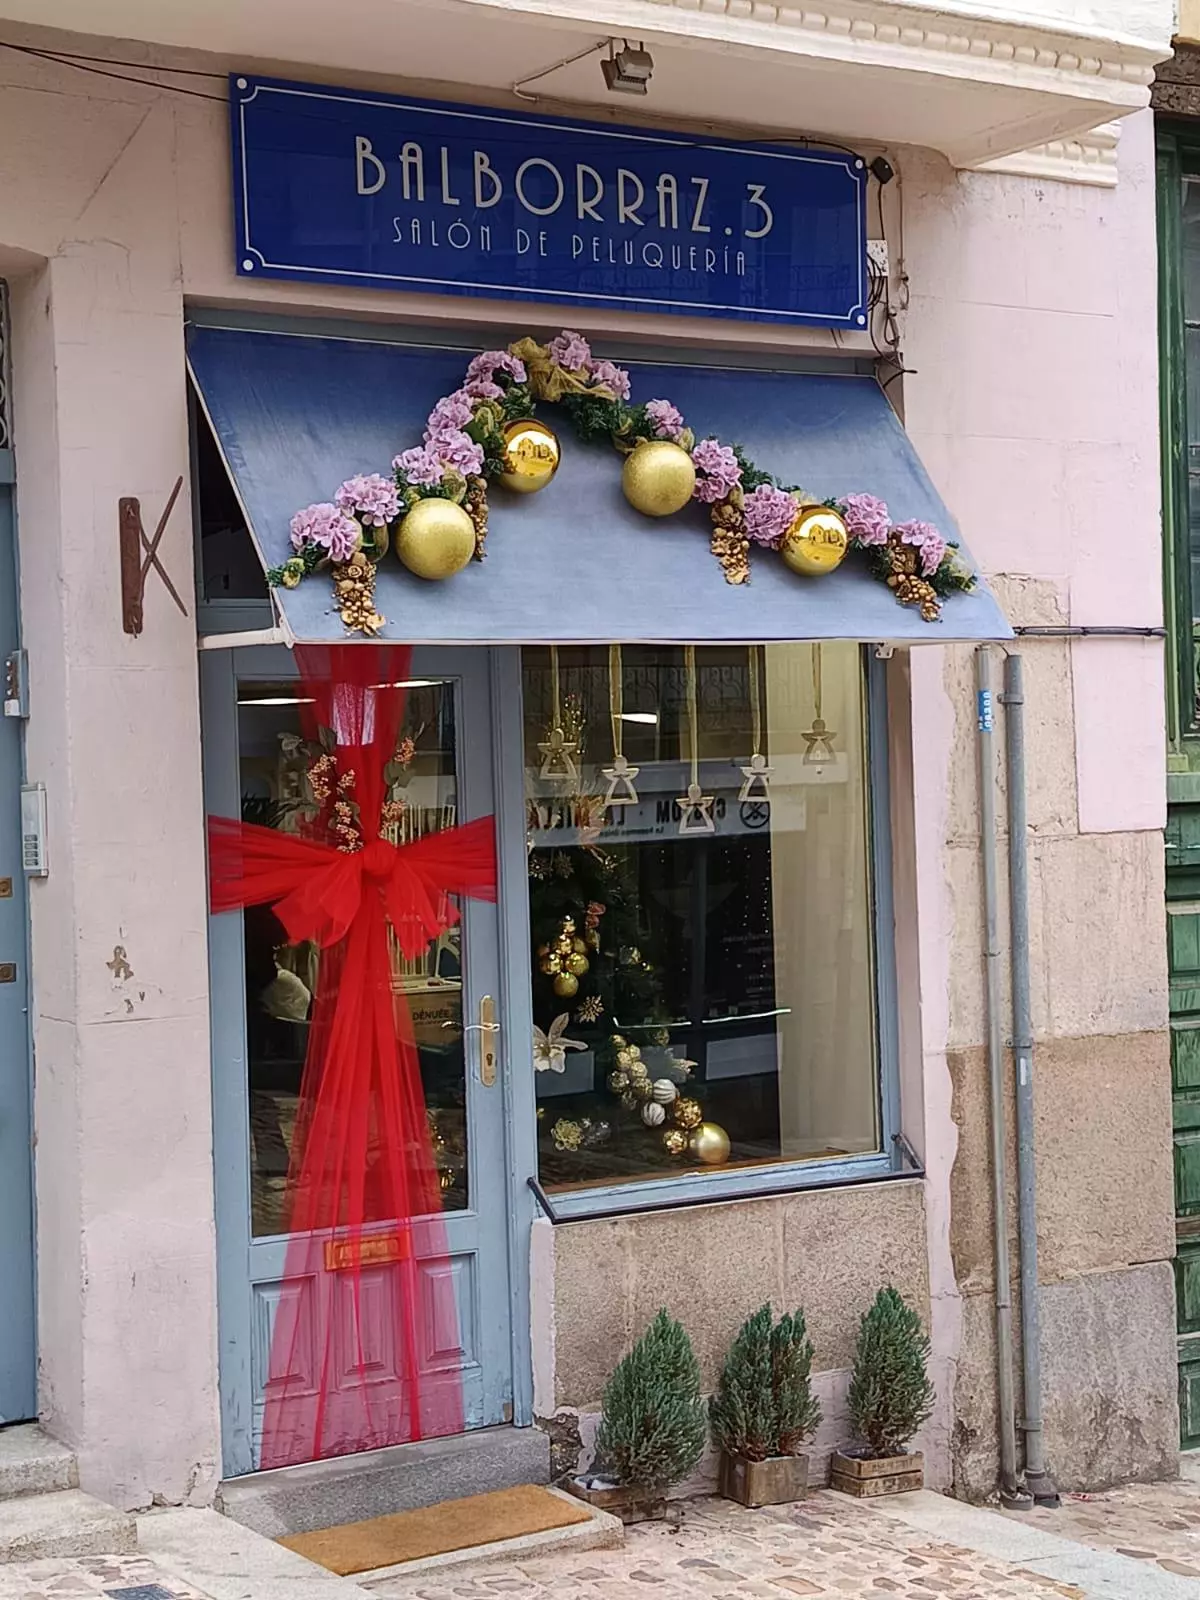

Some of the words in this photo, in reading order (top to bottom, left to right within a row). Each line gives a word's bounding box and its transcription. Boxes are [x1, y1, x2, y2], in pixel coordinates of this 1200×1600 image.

[393, 215, 491, 251] SALÓN
[516, 228, 548, 257] DE
[572, 234, 745, 276] PELUQUERÍA
